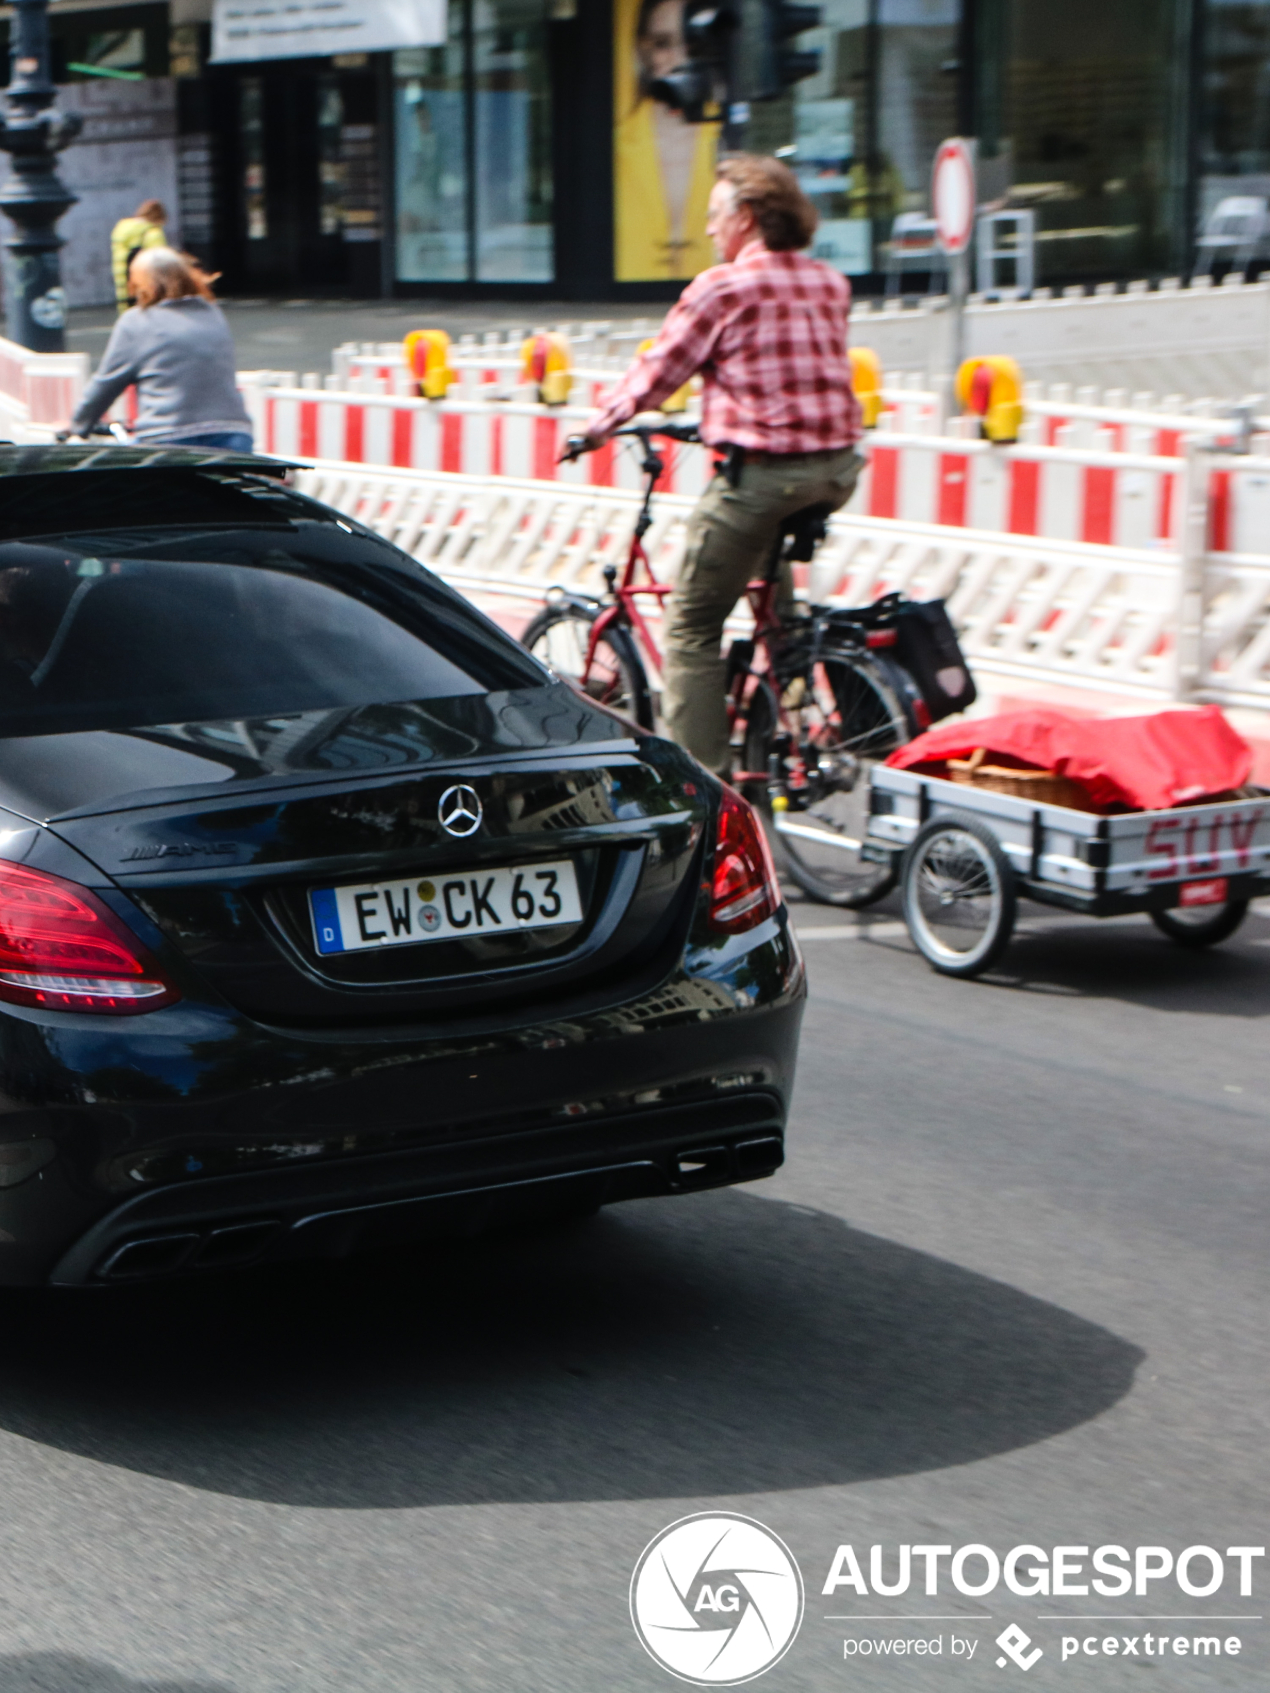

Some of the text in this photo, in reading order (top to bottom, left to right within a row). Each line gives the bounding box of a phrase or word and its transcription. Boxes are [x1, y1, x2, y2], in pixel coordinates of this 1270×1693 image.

[1145, 808, 1264, 879] SUV
[323, 927, 335, 942] D
[354, 870, 562, 942] EW CK 63
